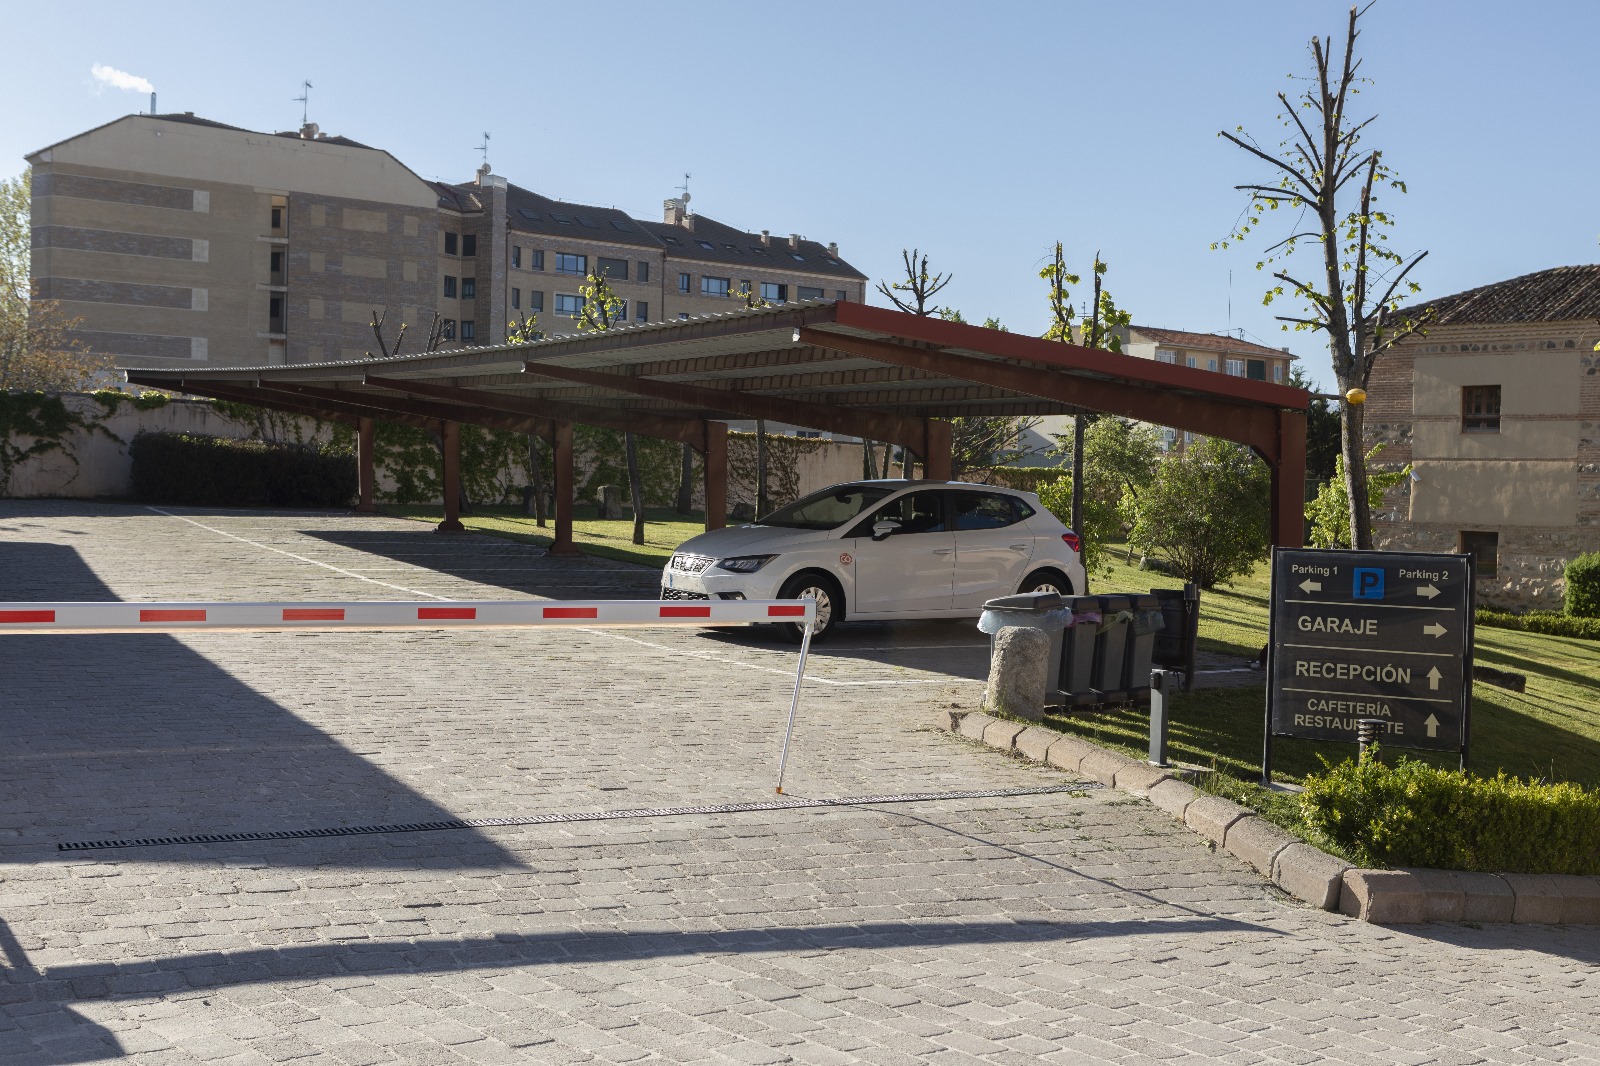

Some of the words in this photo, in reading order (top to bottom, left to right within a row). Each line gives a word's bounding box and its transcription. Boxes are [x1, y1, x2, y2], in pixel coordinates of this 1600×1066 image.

[1292, 565, 1330, 577] Parking
[1333, 566, 1338, 575] 1
[1399, 569, 1439, 581] Parking
[1442, 571, 1449, 580] 2
[1359, 571, 1379, 596] P
[1298, 616, 1378, 635] GARAJE
[1295, 661, 1411, 684] RECEPCIÓN
[1307, 699, 1392, 717] CAFETERÍA
[1294, 713, 1404, 735] RESTAURTE
